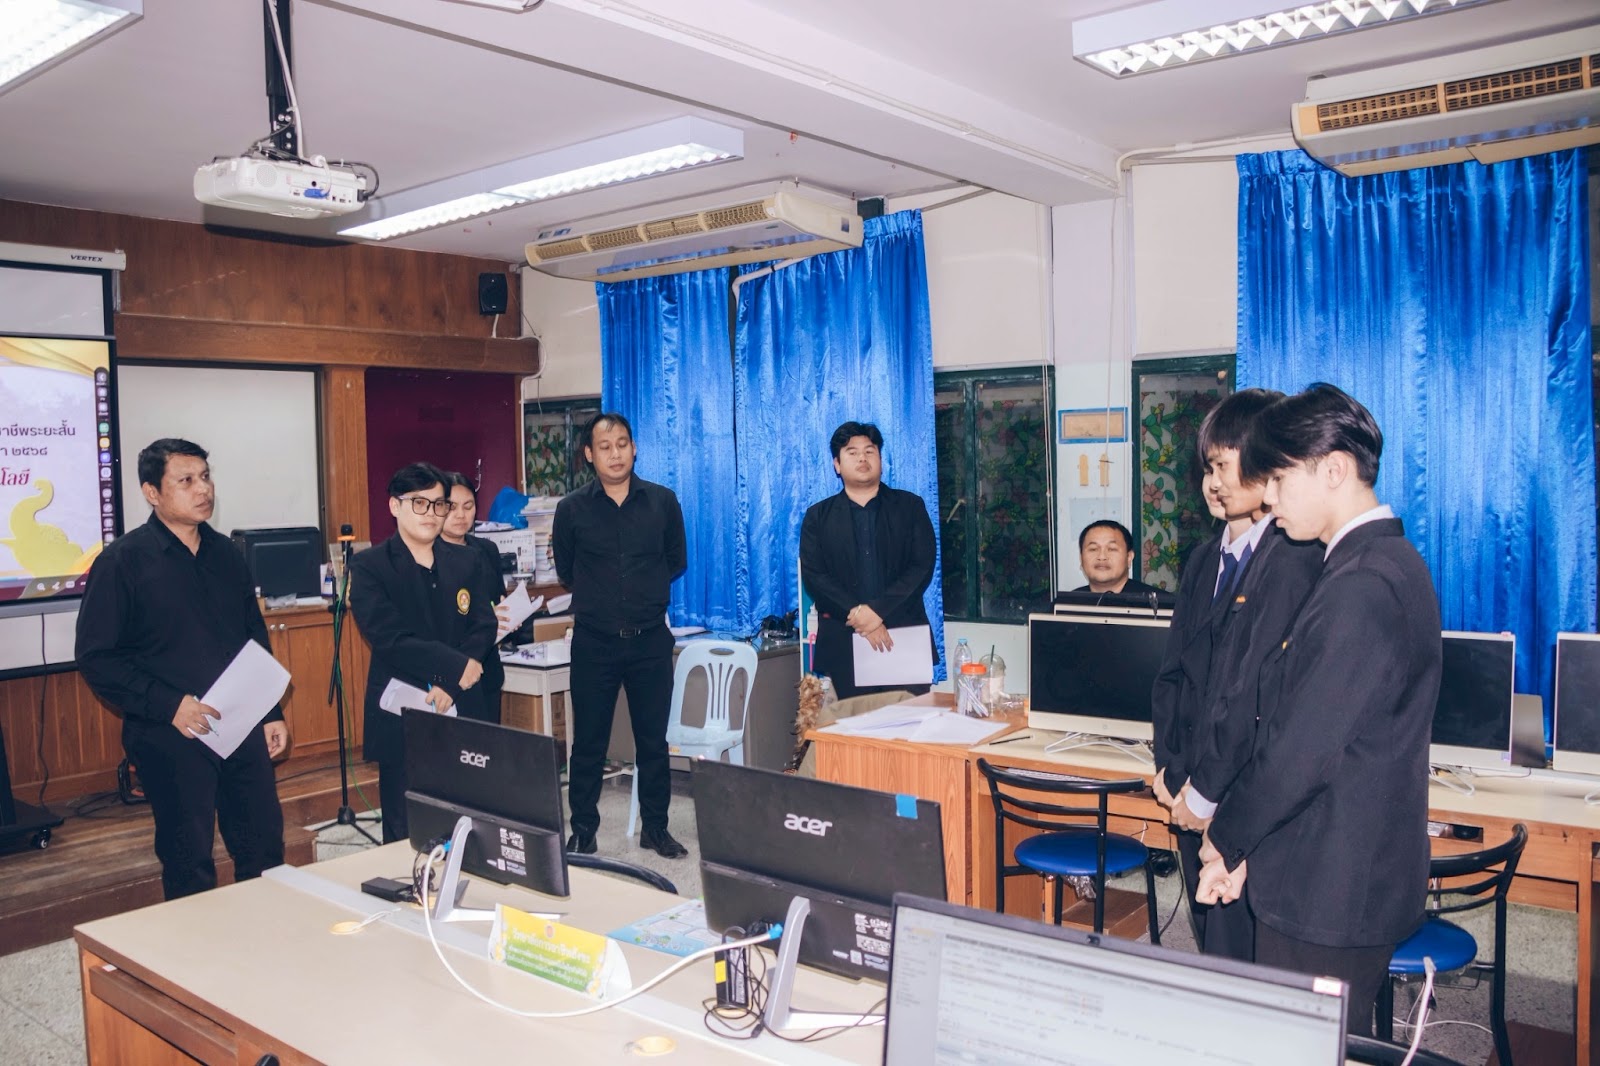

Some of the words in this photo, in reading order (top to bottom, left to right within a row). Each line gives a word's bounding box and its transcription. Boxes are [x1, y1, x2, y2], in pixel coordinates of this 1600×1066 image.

[70, 254, 104, 263] VERTEX
[0, 467, 31, 486] โลยี
[460, 750, 490, 769] acer
[784, 812, 833, 837] acer
